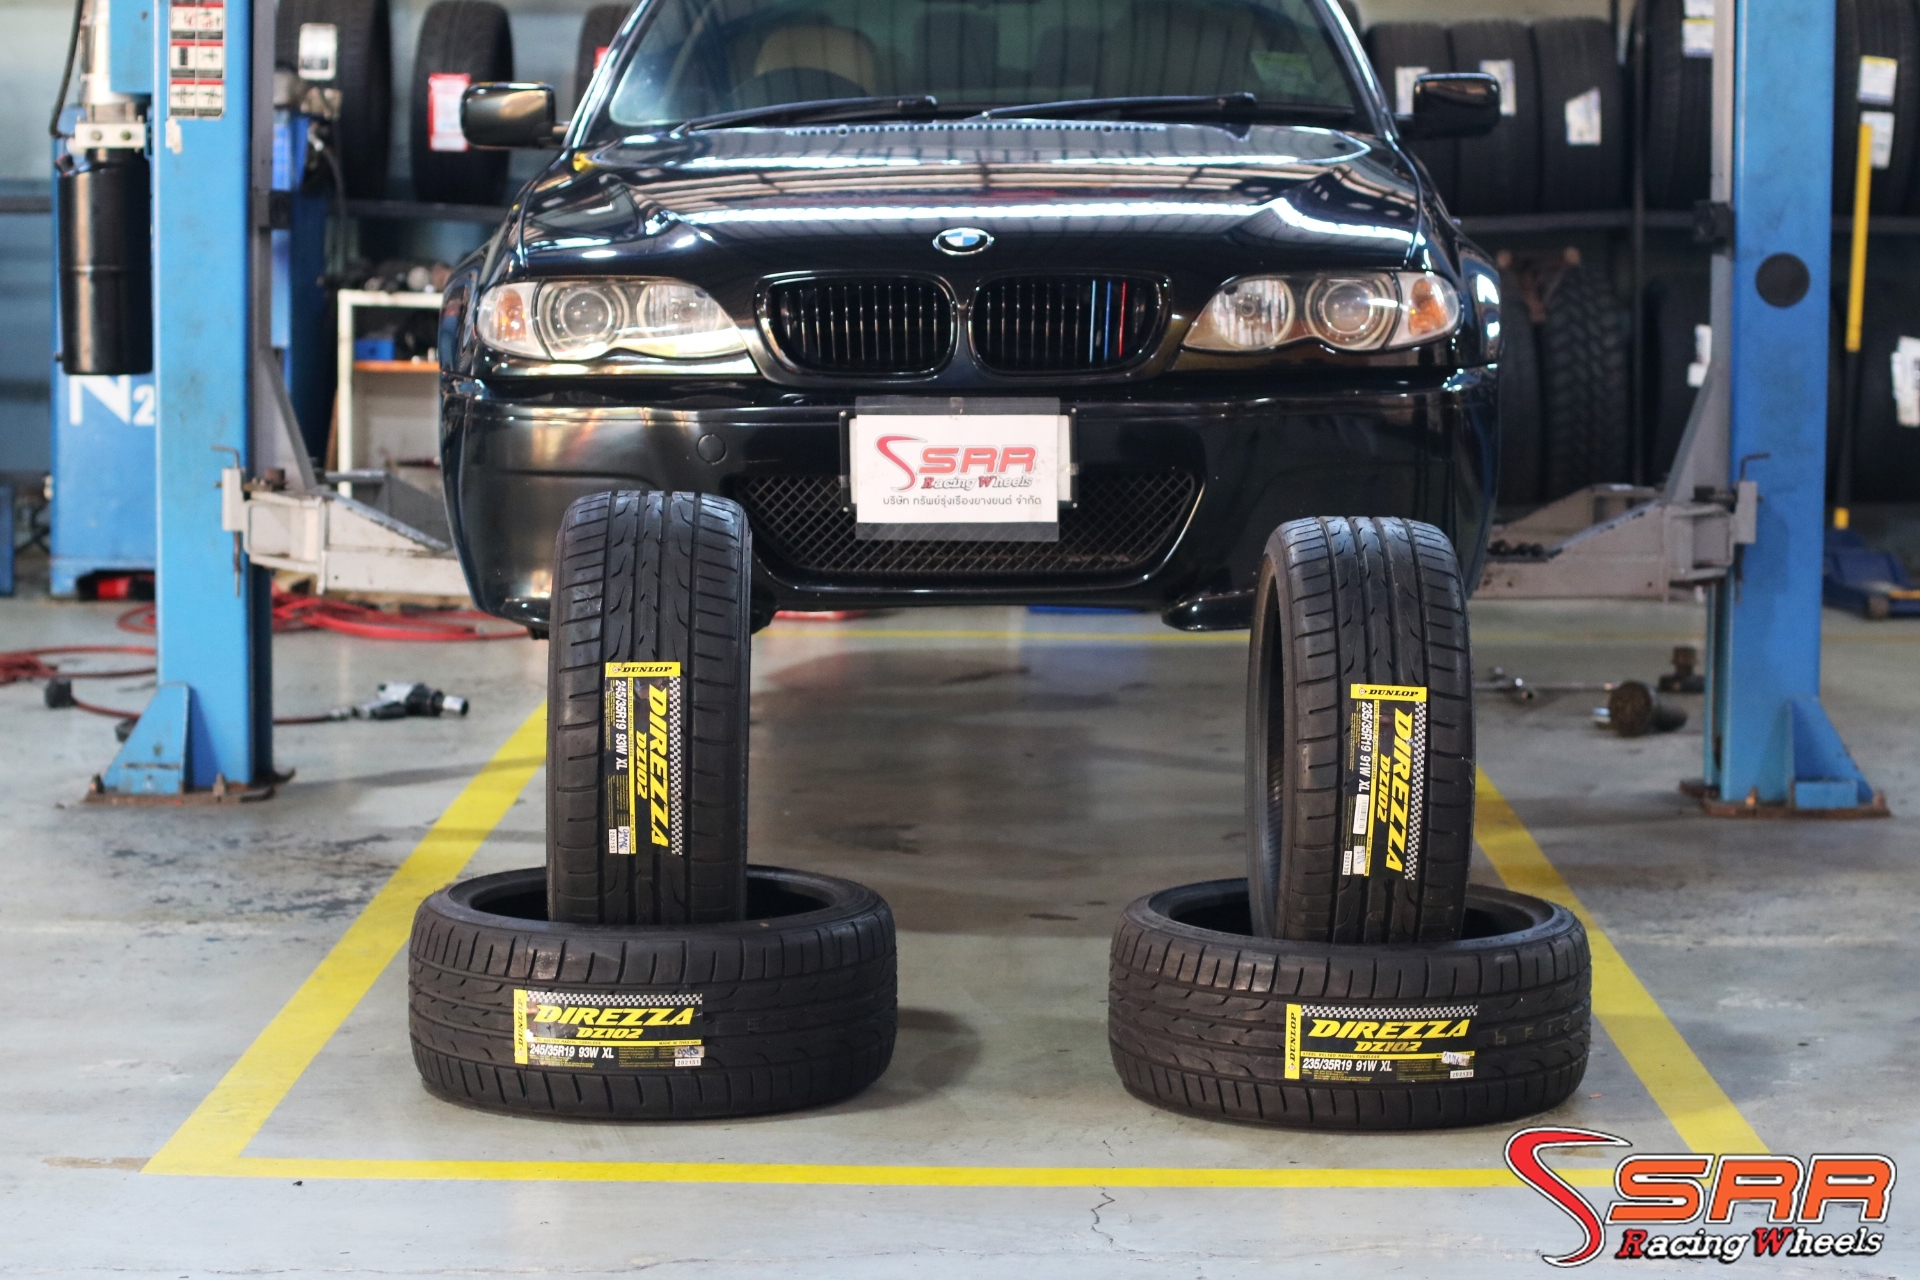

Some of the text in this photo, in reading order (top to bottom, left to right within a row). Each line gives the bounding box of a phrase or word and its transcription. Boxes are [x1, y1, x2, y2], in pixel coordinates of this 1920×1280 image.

[921, 475, 1034, 490] Racing Wheels
[883, 495, 910, 506] บริษัท
[1016, 495, 1042, 506] จำกัด
[1368, 689, 1419, 697] DUNLOP
[615, 679, 627, 730] 245/35R19
[615, 732, 628, 756] 93W
[1358, 701, 1374, 793] 235/35R19 91W XL
[616, 756, 628, 771] XL
[636, 730, 648, 800] DZ102
[649, 683, 669, 848] DIREZZA
[1377, 753, 1391, 823] DZ102
[1386, 707, 1413, 872] DIREZZA
[533, 1004, 695, 1026] DIREZZA
[576, 1027, 644, 1039] DZ102
[1308, 1019, 1471, 1039] DIREZZA
[530, 1043, 576, 1057] 245/35R19
[578, 1046, 600, 1059] 93W
[601, 1047, 614, 1059] XL
[1353, 1041, 1423, 1052] DZ102
[1302, 1057, 1353, 1071] 235/35R19
[1355, 1060, 1377, 1072] 91W
[1379, 1060, 1393, 1072] XL
